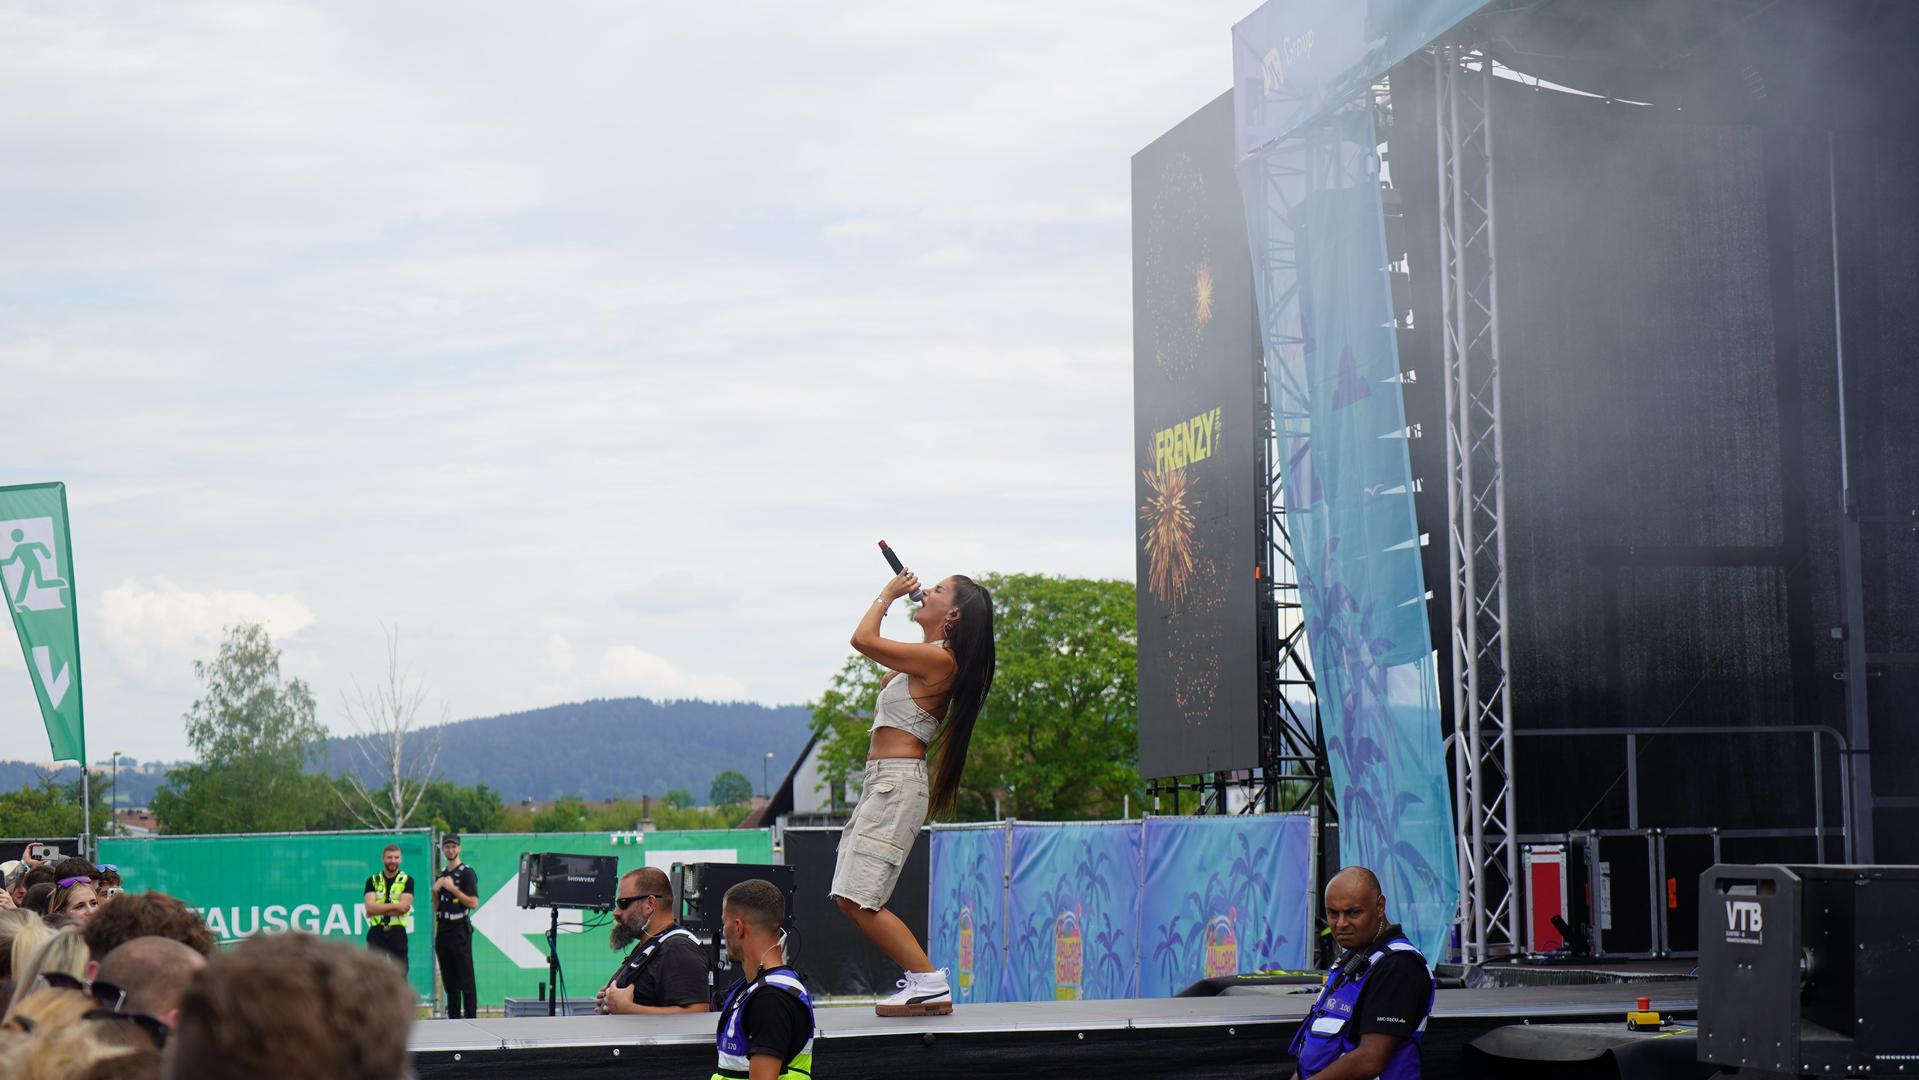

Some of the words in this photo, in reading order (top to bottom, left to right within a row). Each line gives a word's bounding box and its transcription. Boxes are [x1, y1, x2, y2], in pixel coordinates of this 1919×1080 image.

[1155, 409, 1215, 477] FRENZY
[185, 902, 415, 939] AUSGAN
[1725, 900, 1762, 932] VTB
